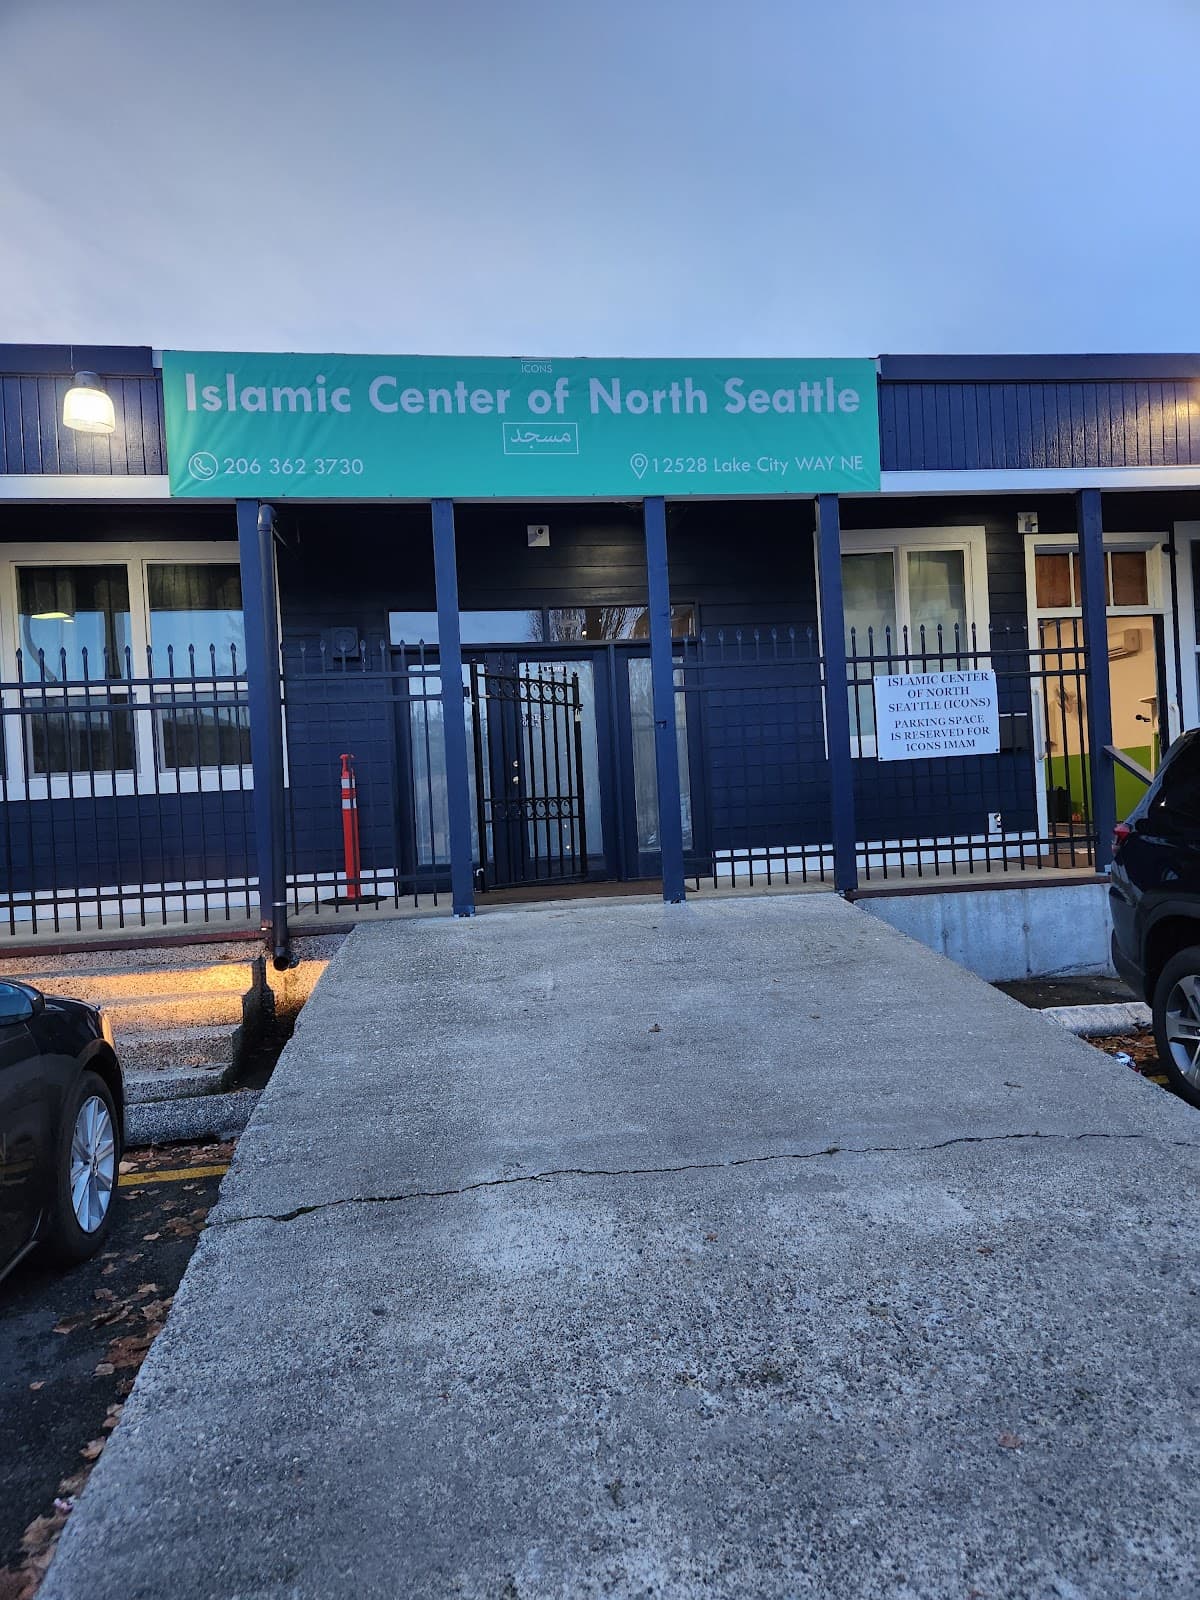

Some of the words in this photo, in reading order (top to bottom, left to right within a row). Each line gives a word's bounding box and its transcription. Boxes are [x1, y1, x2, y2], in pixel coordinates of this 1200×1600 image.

[521, 363, 552, 374] ICONS
[185, 373, 351, 413] Islamic
[368, 375, 511, 415] Center
[527, 376, 570, 415] of
[588, 376, 708, 415] North
[724, 376, 860, 414] Seattle
[510, 428, 572, 449] مسجد
[223, 457, 262, 475] 206
[269, 458, 307, 475] 362
[313, 458, 364, 475] 3730
[652, 457, 707, 474] 12528
[713, 456, 750, 472] Lake
[756, 456, 789, 475] City
[795, 455, 835, 471] WAY
[841, 455, 864, 470] NE
[887, 674, 939, 687] ISLAMIC
[941, 672, 989, 683] CENTER
[907, 689, 924, 699] OF
[926, 686, 969, 698] NORTH
[888, 700, 941, 713] SEATTLE
[943, 697, 991, 710] (ICONS)
[895, 717, 946, 729] PARKING
[948, 714, 985, 726] SPACE
[891, 732, 901, 741] IS
[904, 728, 964, 741] RESERVED
[967, 726, 991, 736] FOR
[906, 742, 941, 752] ICONS
[944, 739, 976, 750] IMAM
